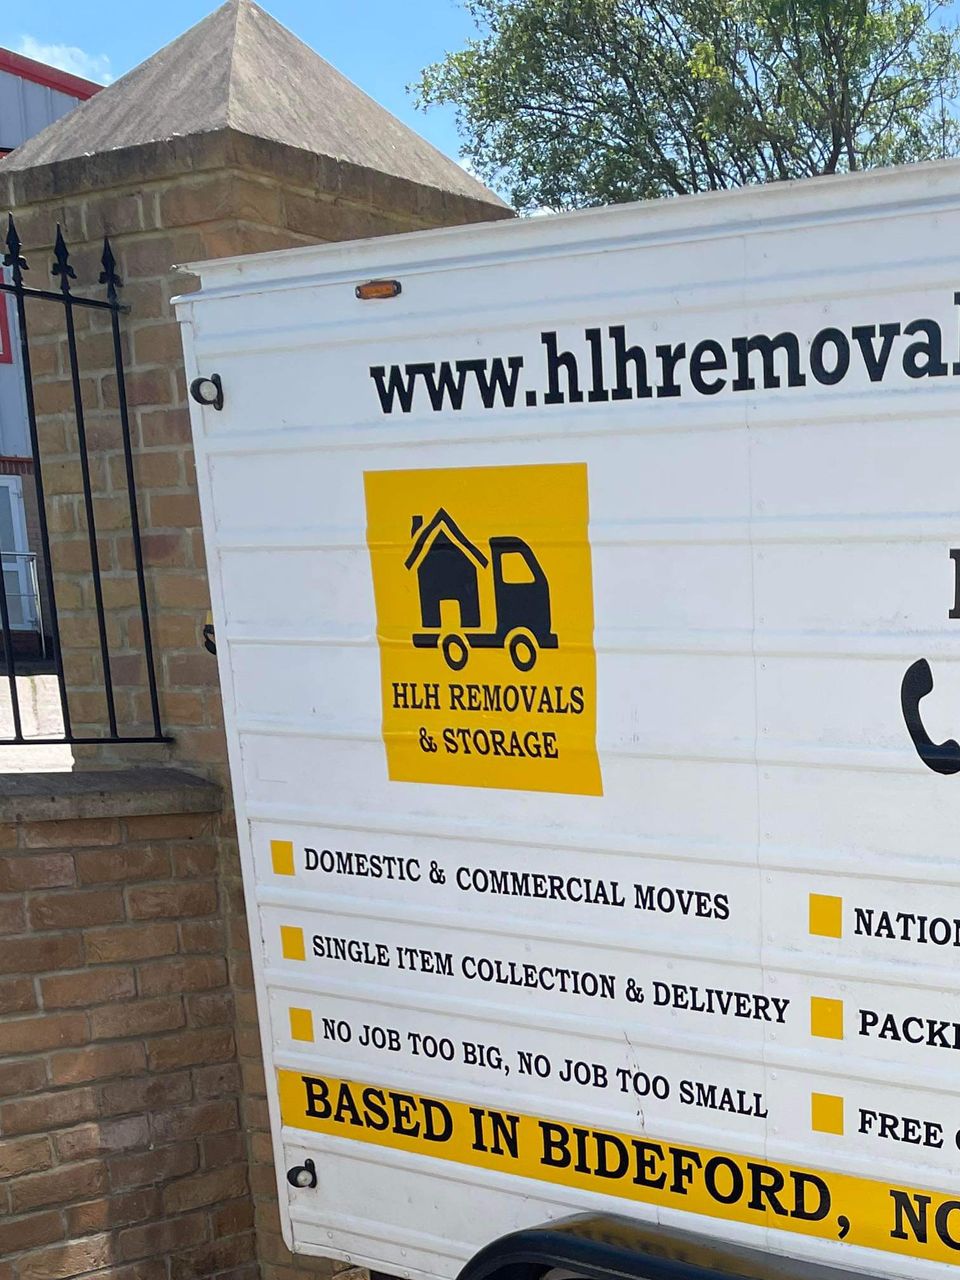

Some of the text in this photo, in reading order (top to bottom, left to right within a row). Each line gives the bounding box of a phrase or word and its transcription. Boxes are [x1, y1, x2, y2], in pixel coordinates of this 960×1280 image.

[392, 682, 585, 715] HLH REMOVALS
[419, 727, 559, 759] & STORAGE
[304, 847, 730, 920] DOMESTIC & COMMERCIAL MOVES
[312, 934, 790, 1024] SINGLE ITEM COLLECTION & DELIVERY
[321, 1017, 769, 1119] NO JOB TOO BIG, NO JOB TOO SMALL
[301, 1075, 453, 1143] BASED
[469, 1107, 520, 1159] IN
[539, 1120, 851, 1240] BIDEFORD,
[858, 1108, 944, 1149] FREE
